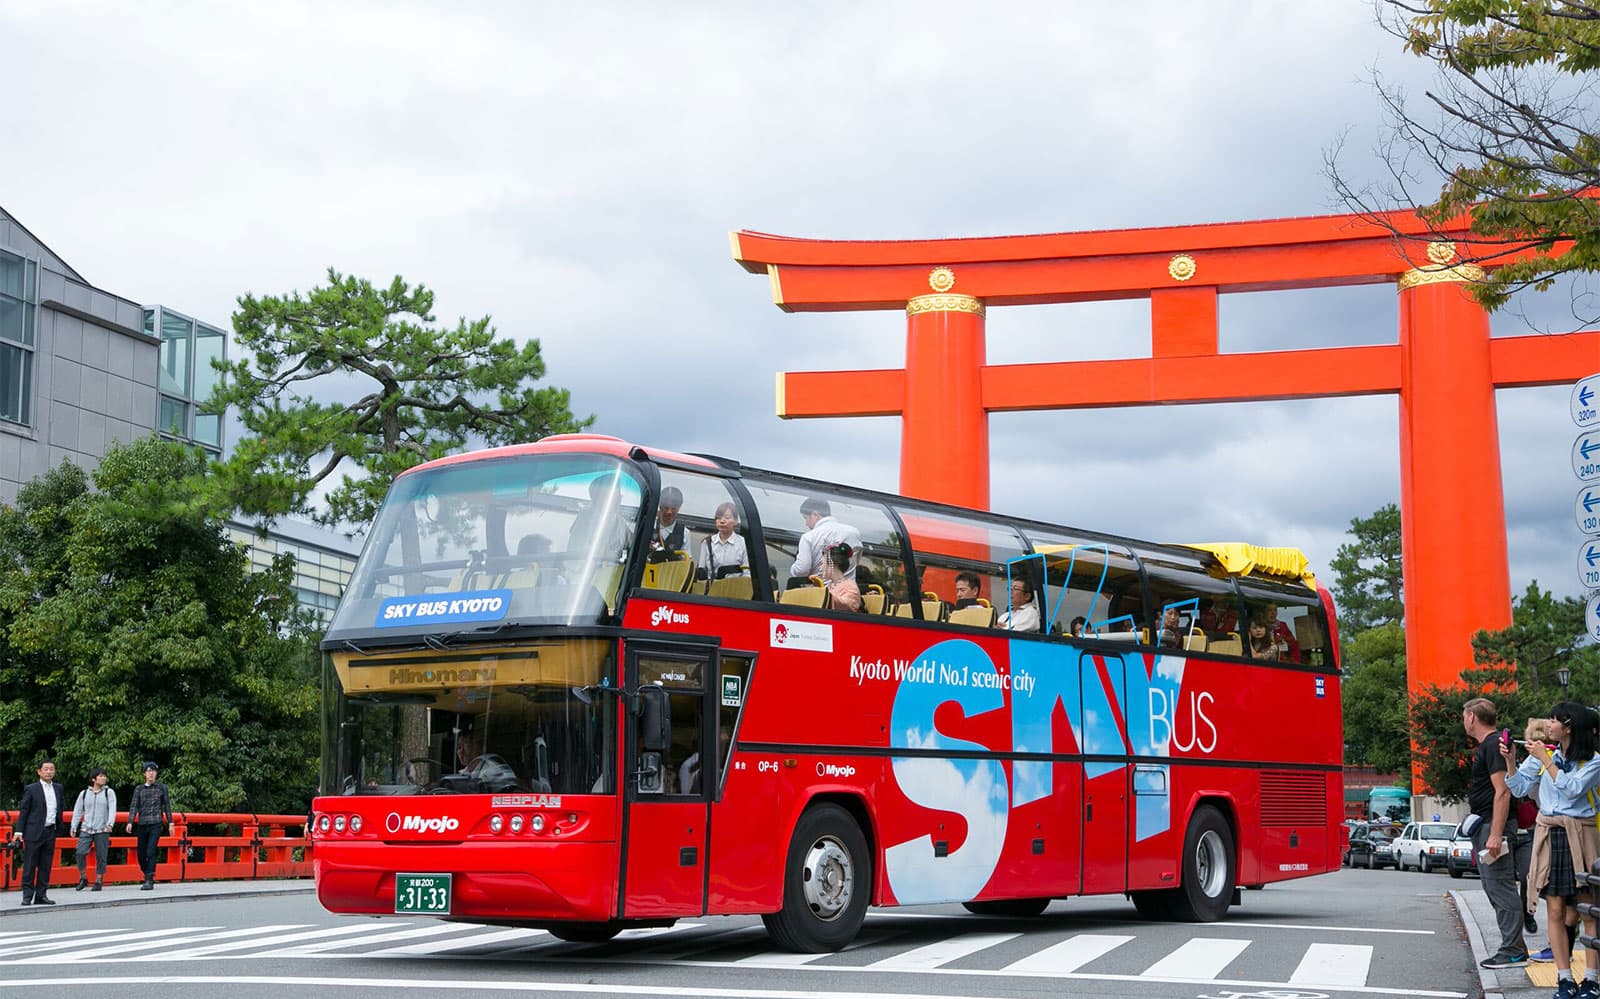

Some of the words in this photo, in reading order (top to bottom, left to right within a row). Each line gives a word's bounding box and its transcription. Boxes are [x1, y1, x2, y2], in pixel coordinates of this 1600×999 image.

[1578, 409, 1597, 421] 320m
[1580, 463, 1594, 477] 240
[1584, 516, 1597, 530] 130
[1586, 571, 1600, 584] 710
[384, 603, 418, 619] SKY
[416, 601, 448, 616] BUS
[448, 597, 503, 614] KYOTO
[651, 605, 674, 626] SKY
[673, 613, 690, 624] BUS
[389, 668, 497, 684] Hinomaru
[850, 655, 890, 686] Kyoto
[893, 659, 935, 684] World
[939, 662, 968, 686] No.1
[971, 667, 1011, 690] scenic
[1013, 669, 1036, 698] city
[1149, 687, 1218, 753] BUS
[758, 760, 779, 773] OP-6
[826, 764, 856, 777] Myojo
[491, 794, 562, 808] NEOPLAN
[402, 815, 459, 832] Myojo
